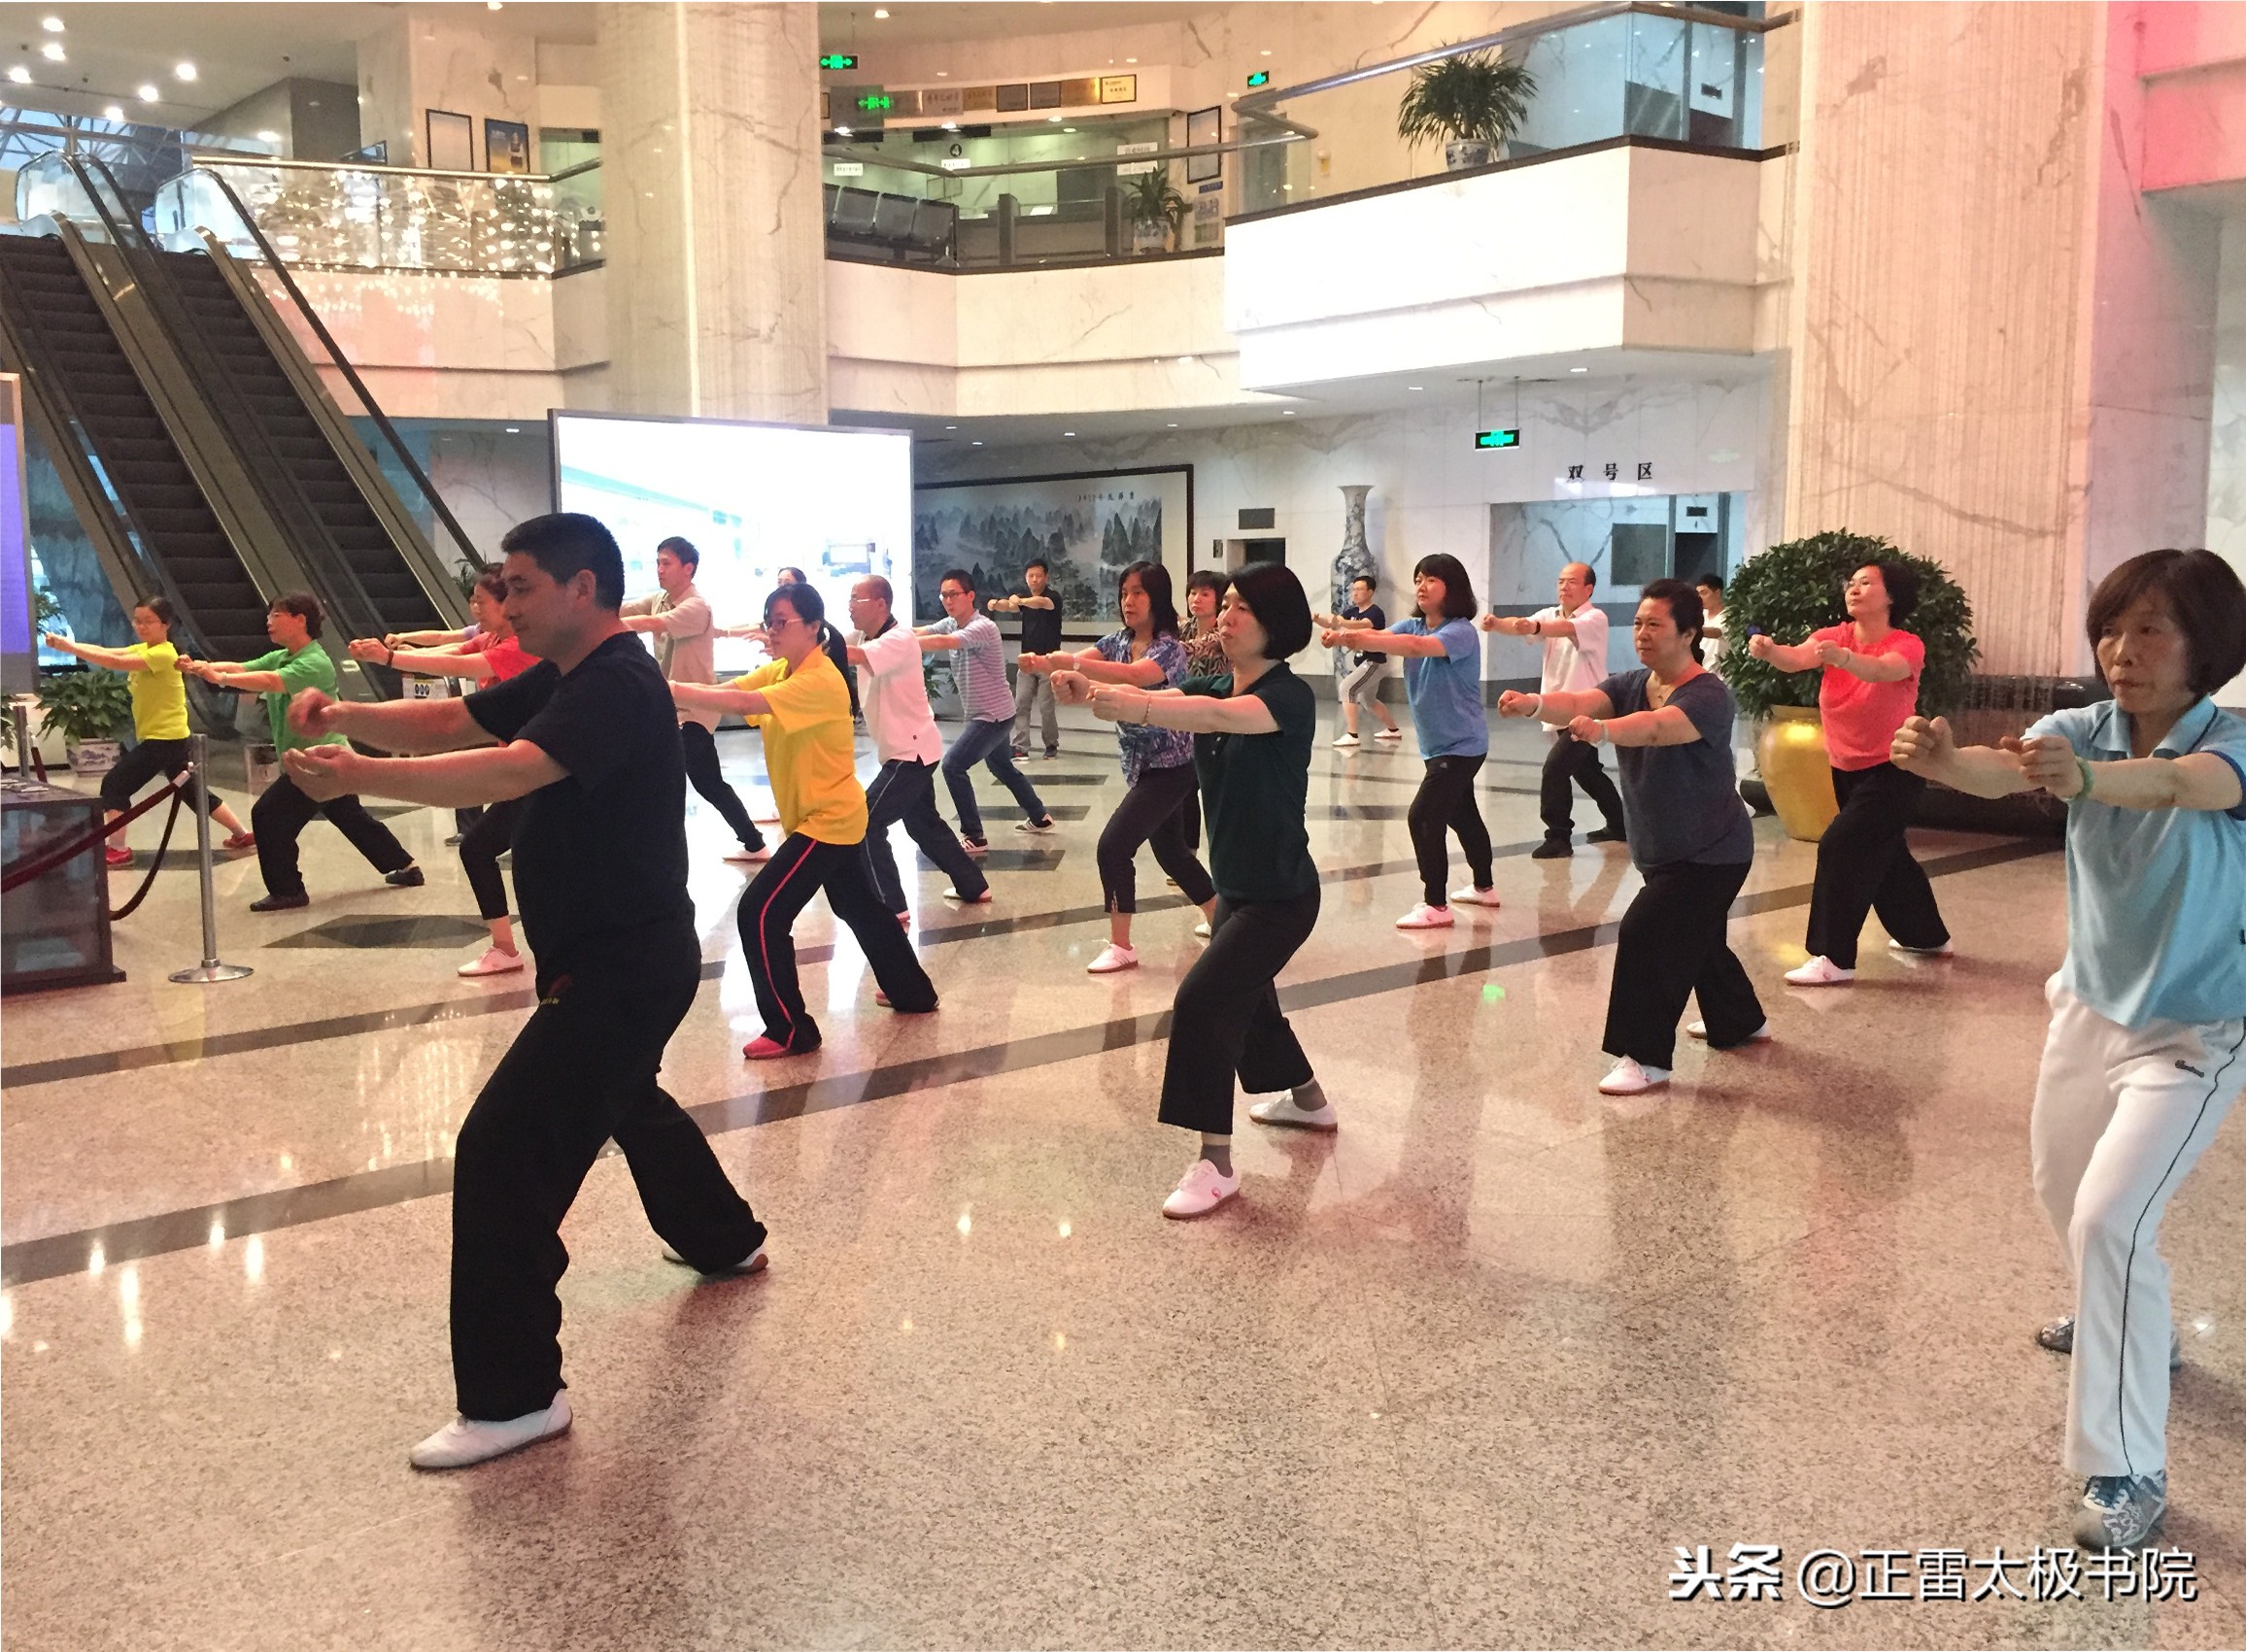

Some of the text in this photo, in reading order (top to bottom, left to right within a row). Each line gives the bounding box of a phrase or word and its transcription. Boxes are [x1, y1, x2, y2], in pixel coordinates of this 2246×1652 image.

[951, 144, 961, 156] 4
[1567, 461, 1653, 482] 双号区
